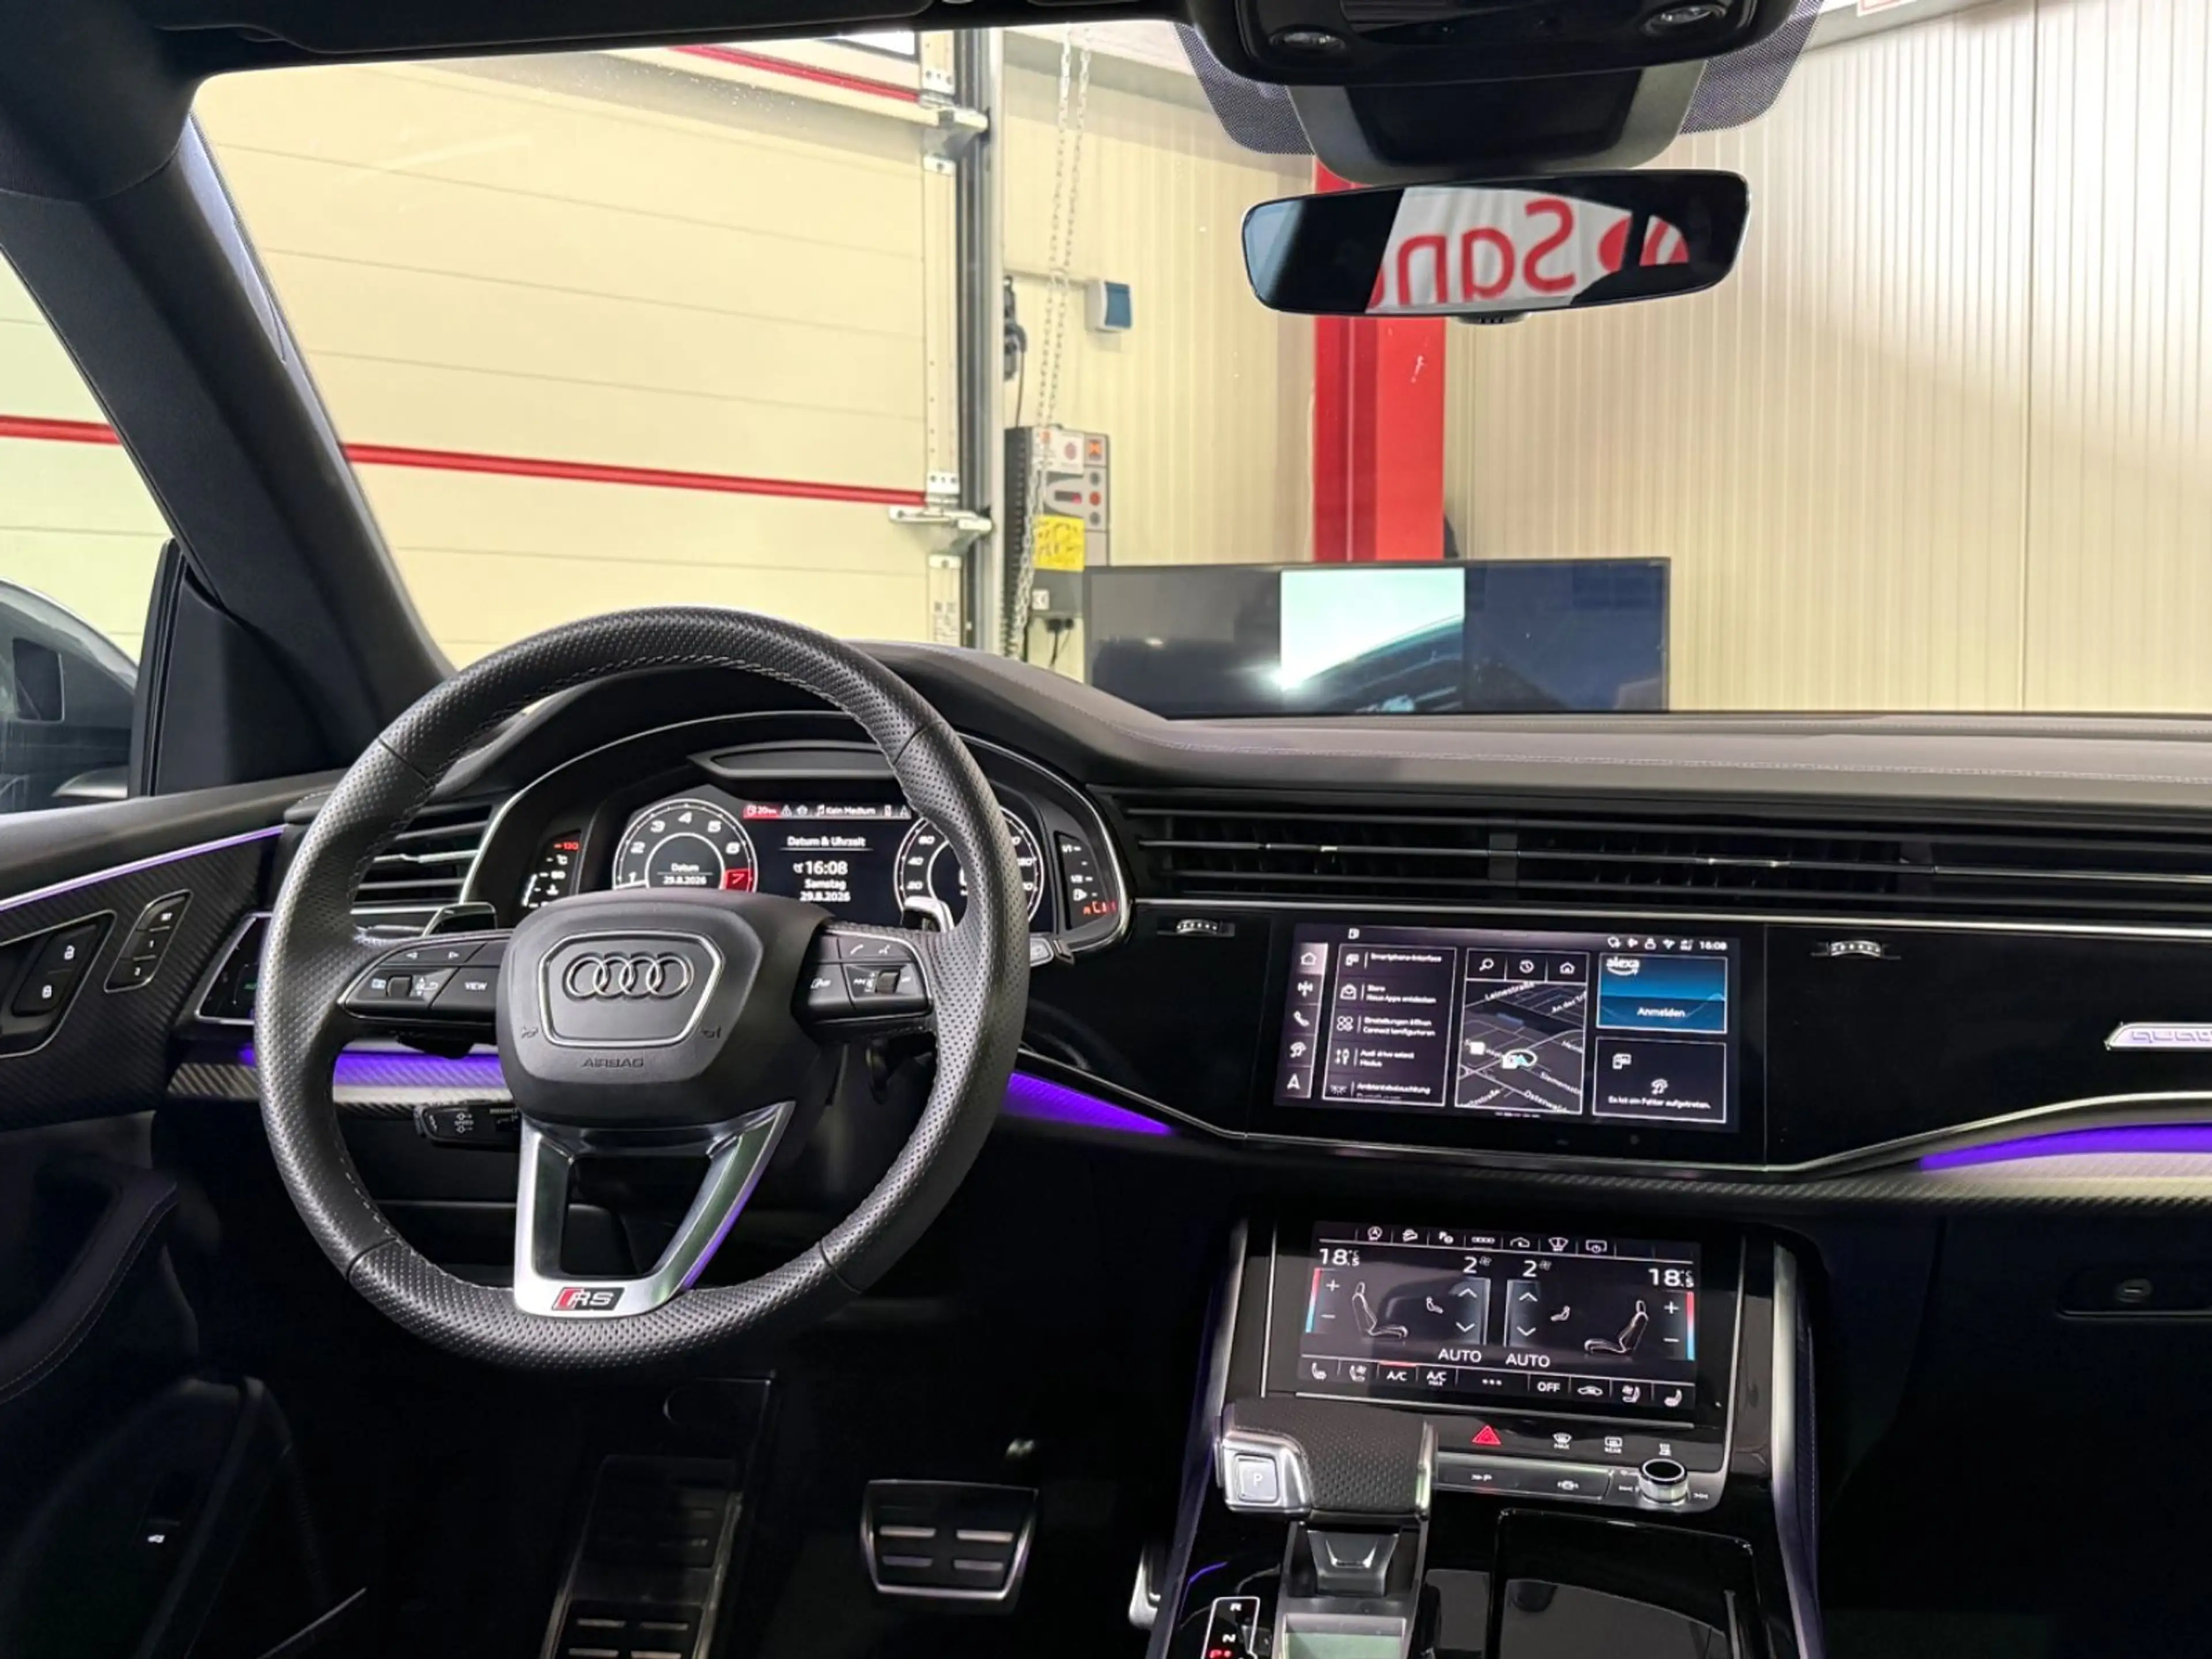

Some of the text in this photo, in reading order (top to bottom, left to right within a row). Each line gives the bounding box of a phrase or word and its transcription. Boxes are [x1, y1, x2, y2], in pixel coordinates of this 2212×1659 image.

[826, 806, 876, 815] Kein Medium
[678, 812, 692, 824] 4
[650, 820, 665, 833] 3
[707, 820, 721, 833] 5
[630, 841, 645, 854] 2
[787, 836, 866, 847] Datum & Uhrzeit
[725, 842, 740, 855] 6
[907, 856, 924, 866] 40
[671, 863, 699, 872] Datum
[805, 861, 848, 875] 16:08
[628, 872, 637, 882] 1
[732, 874, 744, 884] 7
[804, 879, 847, 891] Samstag
[906, 881, 923, 890] 20
[1605, 956, 1640, 969] alexa
[465, 982, 487, 991] VIEW
[1637, 1007, 1685, 1018] Anmelden
[583, 1058, 644, 1069] AIRBAG
[1463, 1256, 1478, 1274] 2
[1522, 1260, 1537, 1278] 2
[563, 1290, 615, 1308] RS
[1438, 1348, 1482, 1363] AUTO
[1505, 1353, 1551, 1368] AUTO
[1387, 1370, 1408, 1381] A/C
[1426, 1370, 1447, 1381] A/C
[1537, 1381, 1560, 1392] OFF
[1253, 1473, 1263, 1486] P
